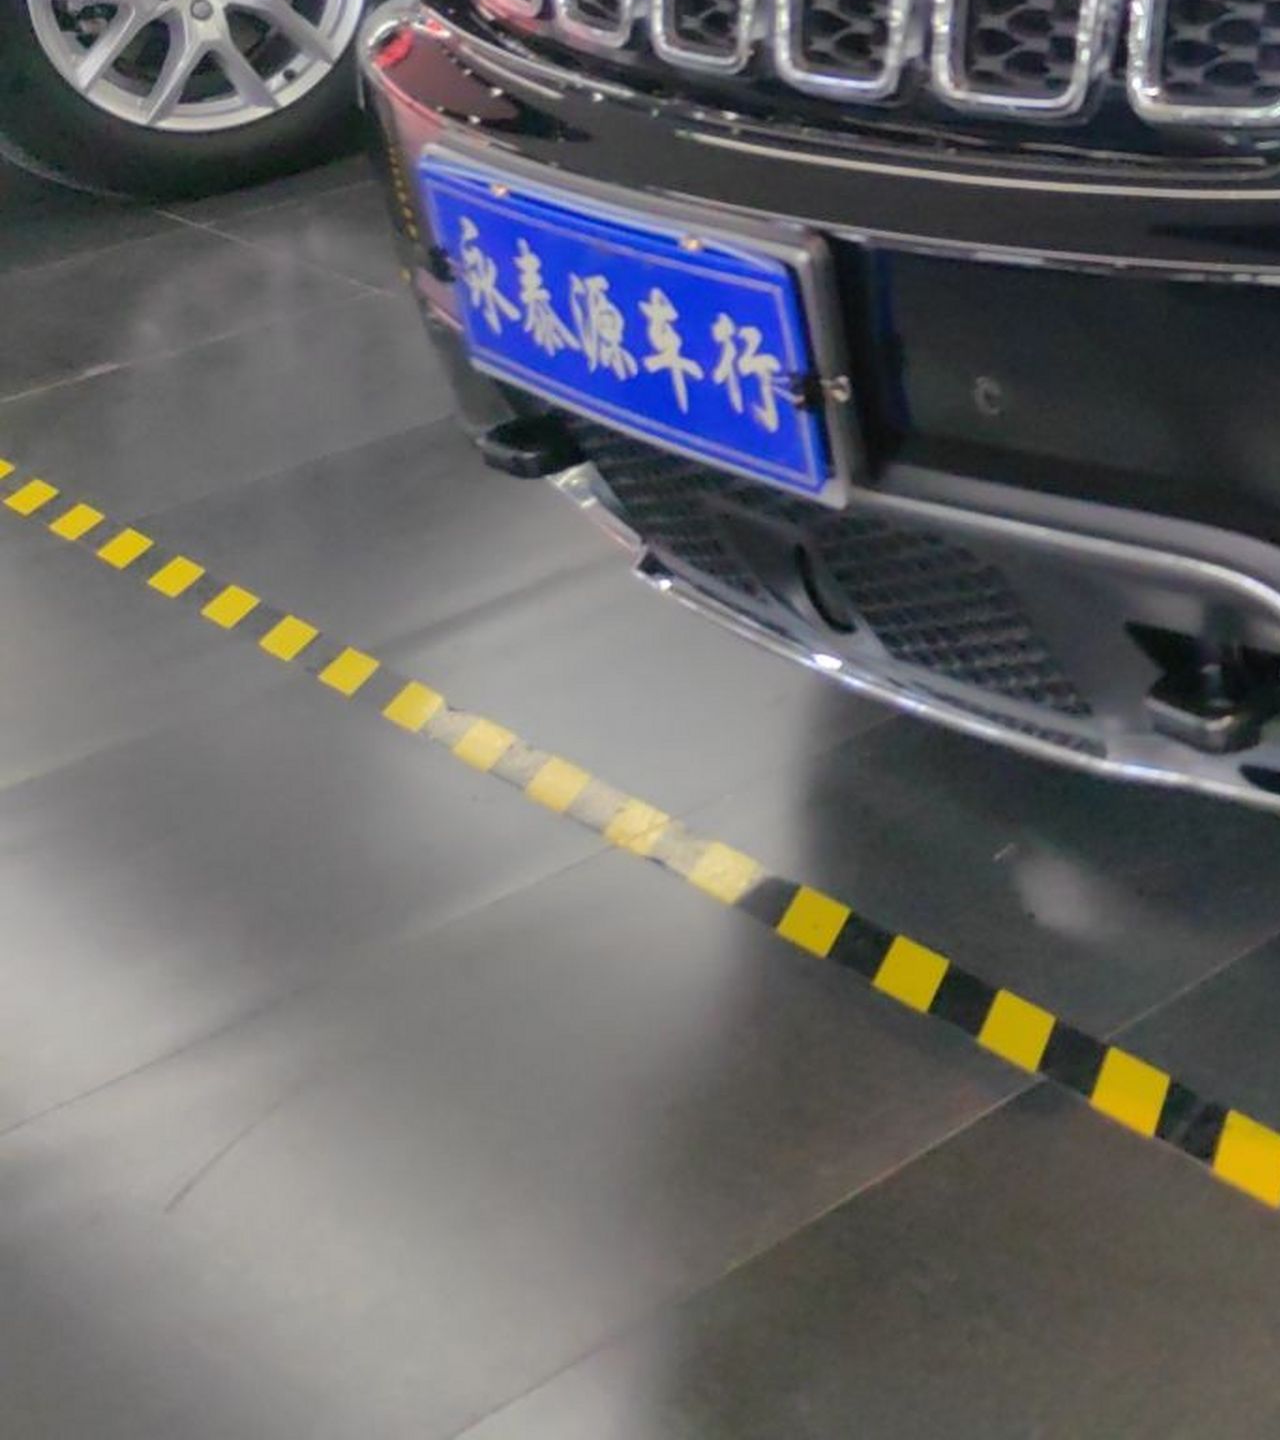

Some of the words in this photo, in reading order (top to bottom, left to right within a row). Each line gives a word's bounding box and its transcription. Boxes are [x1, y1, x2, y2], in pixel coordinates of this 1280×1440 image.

[459, 215, 781, 432] 永泰源车行
